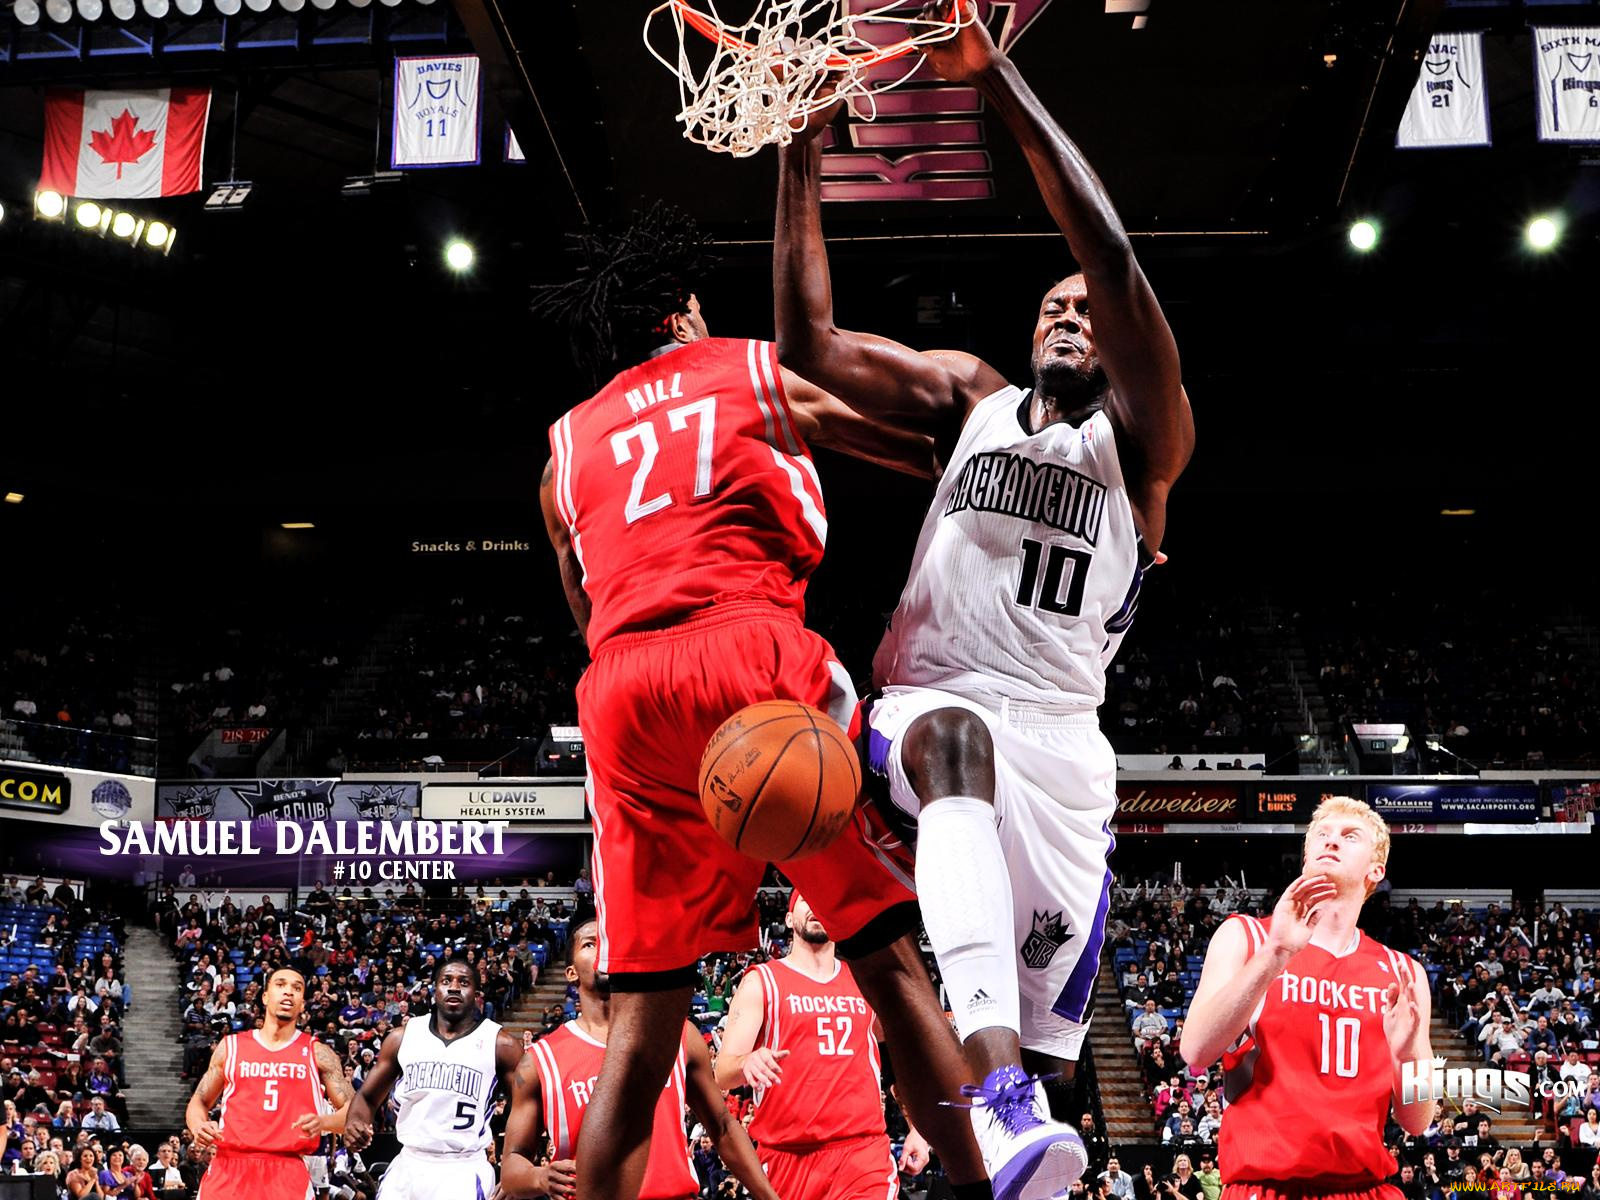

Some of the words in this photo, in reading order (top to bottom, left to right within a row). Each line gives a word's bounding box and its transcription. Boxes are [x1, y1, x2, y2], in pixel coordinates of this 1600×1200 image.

[1541, 36, 1580, 53] SIXTH
[416, 62, 462, 74] DAVIES
[1431, 94, 1450, 107] 21
[415, 105, 459, 120] ROYALS
[426, 118, 447, 137] 11
[624, 372, 684, 414] HILL
[610, 396, 716, 525] 27
[411, 541, 460, 552] Snacks
[465, 541, 476, 551] &
[482, 540, 529, 551] Drinks
[1014, 537, 1093, 617] 10
[0, 778, 62, 805] COM
[1267, 793, 1297, 802] LIONS
[460, 807, 501, 816] HEALTH
[505, 807, 546, 816] SYSTEM
[1402, 823, 1425, 833] 122
[786, 993, 867, 1015] ROCKETS
[817, 1016, 854, 1056] 52
[1318, 1012, 1361, 1078] 10
[239, 1060, 307, 1079] ROCKETS
[404, 1061, 484, 1102] SACRAMENTO
[263, 1080, 279, 1112] 5
[453, 1101, 477, 1130] 5
